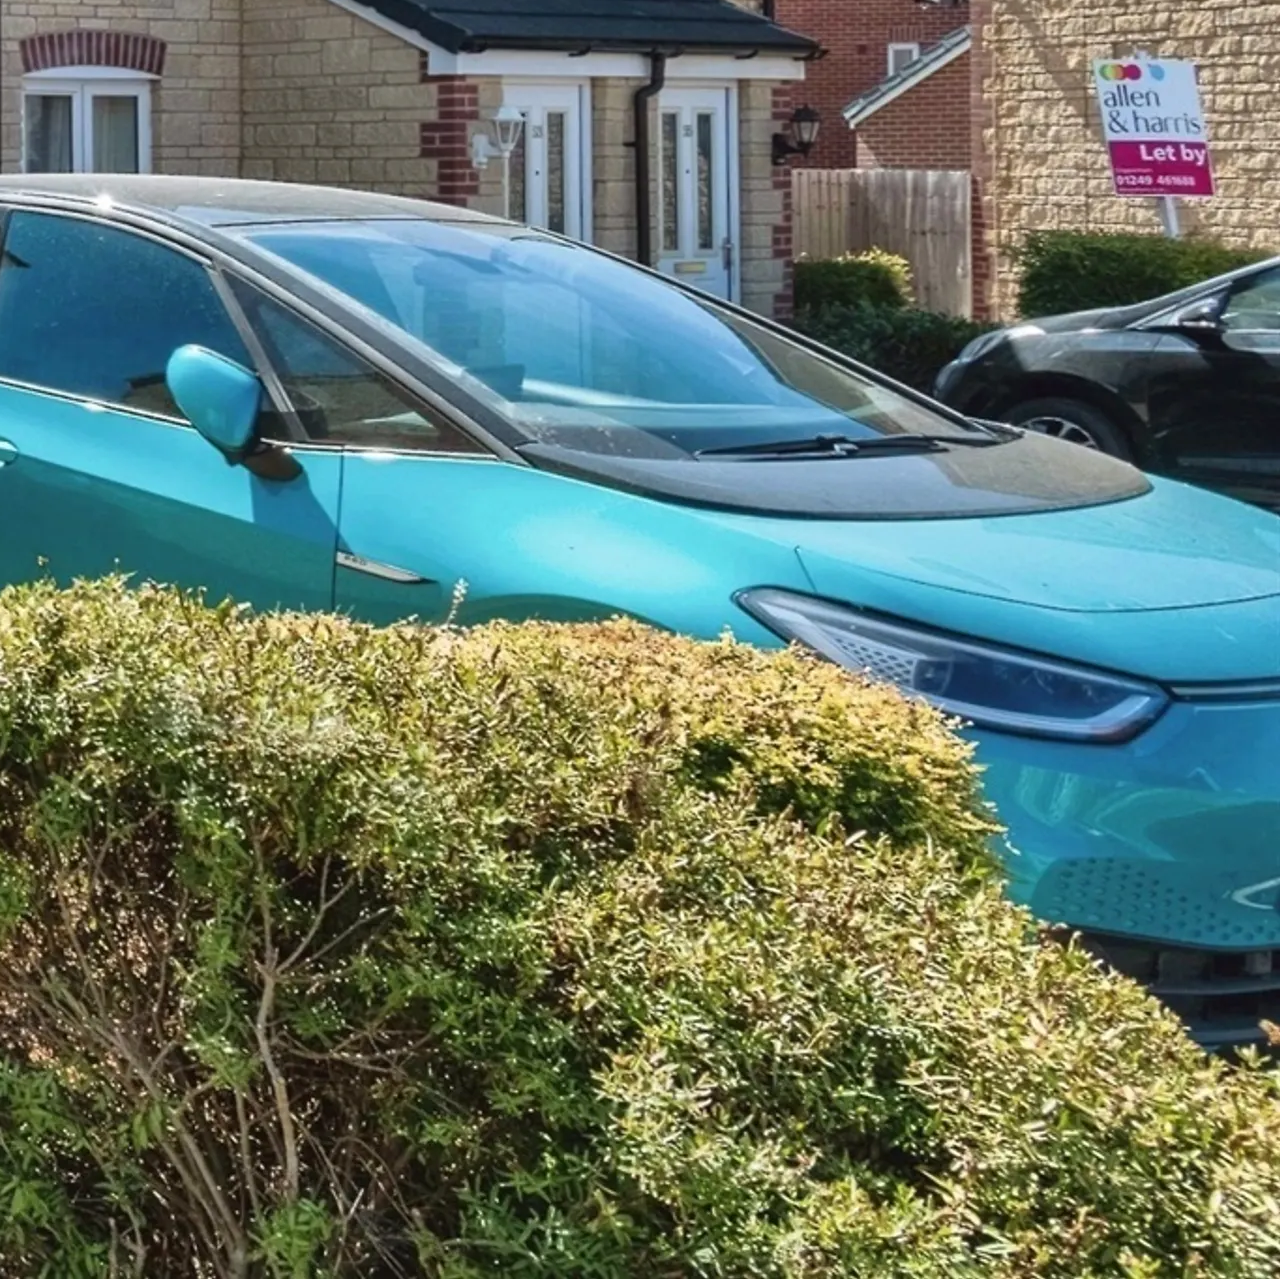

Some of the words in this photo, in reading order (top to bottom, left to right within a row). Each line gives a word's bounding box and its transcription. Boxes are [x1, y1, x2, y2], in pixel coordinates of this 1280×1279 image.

[1103, 84, 1161, 108] allen
[1108, 109, 1129, 134] &
[1132, 110, 1201, 134] harris
[1139, 144, 1177, 162] Let
[1180, 144, 1206, 166] by
